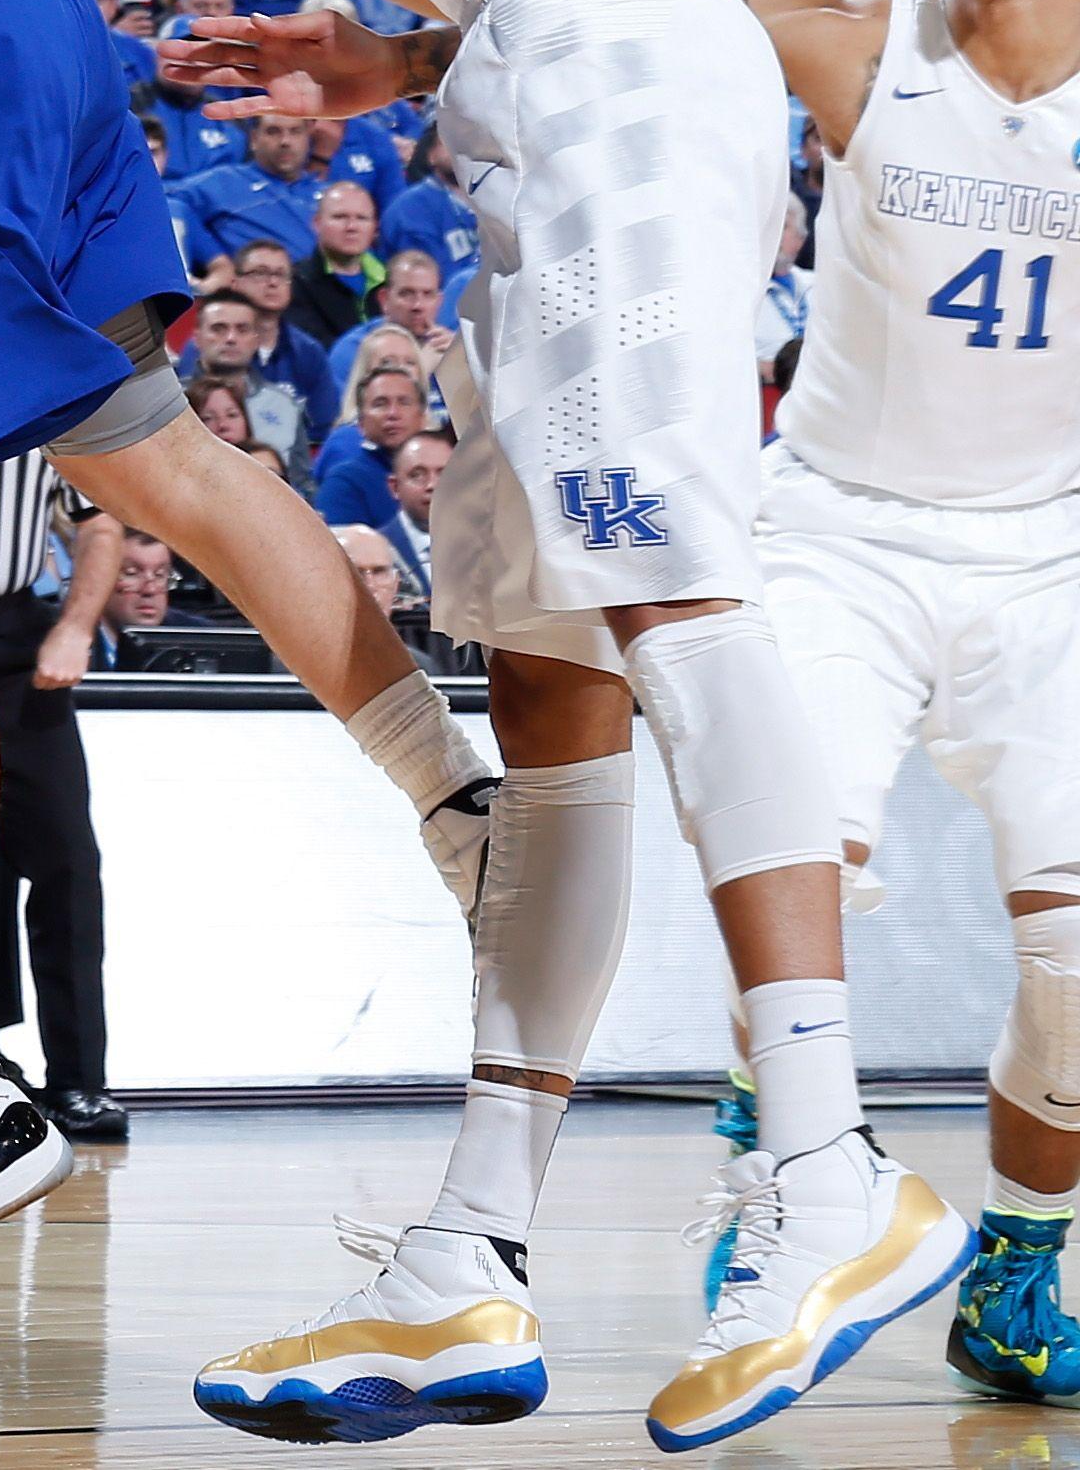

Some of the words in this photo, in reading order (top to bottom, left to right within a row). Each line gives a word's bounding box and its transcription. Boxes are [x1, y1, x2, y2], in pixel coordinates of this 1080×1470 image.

[926, 247, 1056, 350] 41
[555, 467, 669, 550] UK
[472, 1244, 501, 1290] TRILL
